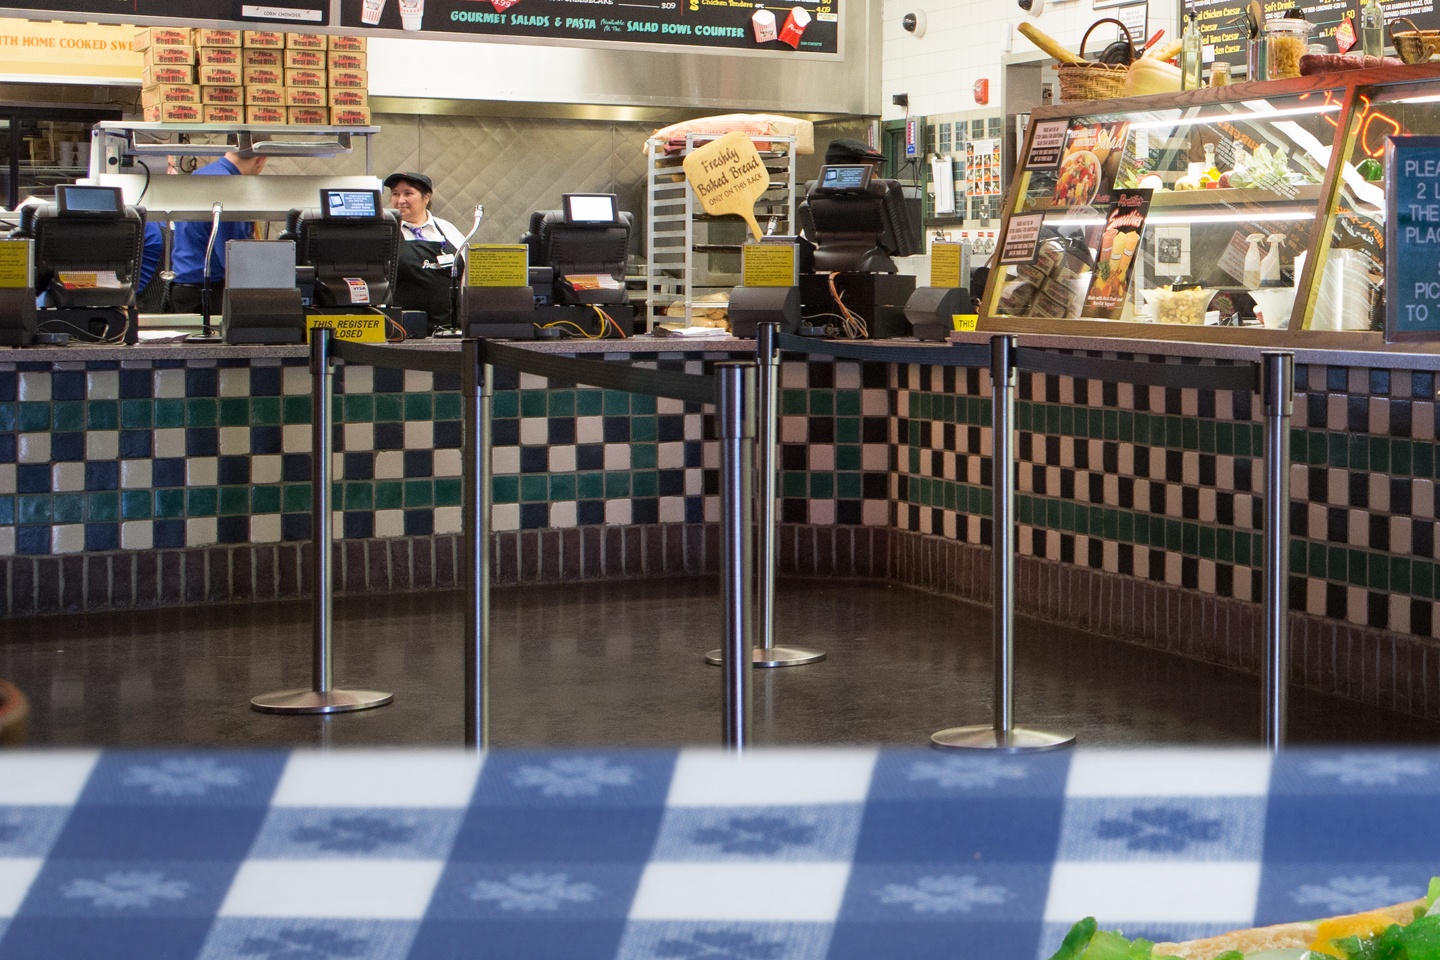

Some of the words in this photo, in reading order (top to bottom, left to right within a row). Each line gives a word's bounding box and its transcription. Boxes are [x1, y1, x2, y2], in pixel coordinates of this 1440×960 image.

[1264, 1, 1277, 13] Soft
[1277, 0, 1296, 11] Drinks
[450, 10, 506, 25] GOURMET
[510, 13, 550, 28] SALADS
[554, 17, 563, 27] &
[565, 17, 597, 29] PASTA
[1203, 9, 1222, 20] Chicken
[1223, 7, 1241, 17] Caesar
[626, 20, 659, 33] SALAD
[661, 23, 692, 35] BOWL
[694, 25, 745, 38] COUNTER
[1200, 23, 1218, 32] Caesar
[22, 37, 56, 48] HOME
[60, 38, 107, 50] COOKED
[1210, 34, 1221, 43] Tuna
[1222, 32, 1239, 42] Caesar
[1225, 44, 1241, 54] Caesar
[159, 55, 174, 63] Best
[174, 55, 188, 63] Ribs
[156, 75, 171, 83] Best
[171, 75, 185, 83] Ribs
[166, 94, 180, 102] Best
[180, 94, 194, 102] Ribs
[1093, 125, 1128, 151] Salad
[701, 147, 740, 174] Freshly
[697, 172, 729, 197] Baked
[729, 156, 760, 180] Bread
[708, 192, 724, 206] ONLY
[723, 188, 735, 198] ON
[734, 182, 747, 193] THIS
[747, 172, 763, 185] RACK
[1416, 182, 1427, 199] 2
[1408, 204, 1440, 221] THE
[1106, 208, 1144, 231] Smoothies
[1405, 304, 1428, 321] TO
[313, 320, 333, 328] THIS
[337, 320, 379, 328] REGISTER
[959, 319, 974, 328] THIS
[334, 329, 363, 338] LOSED
